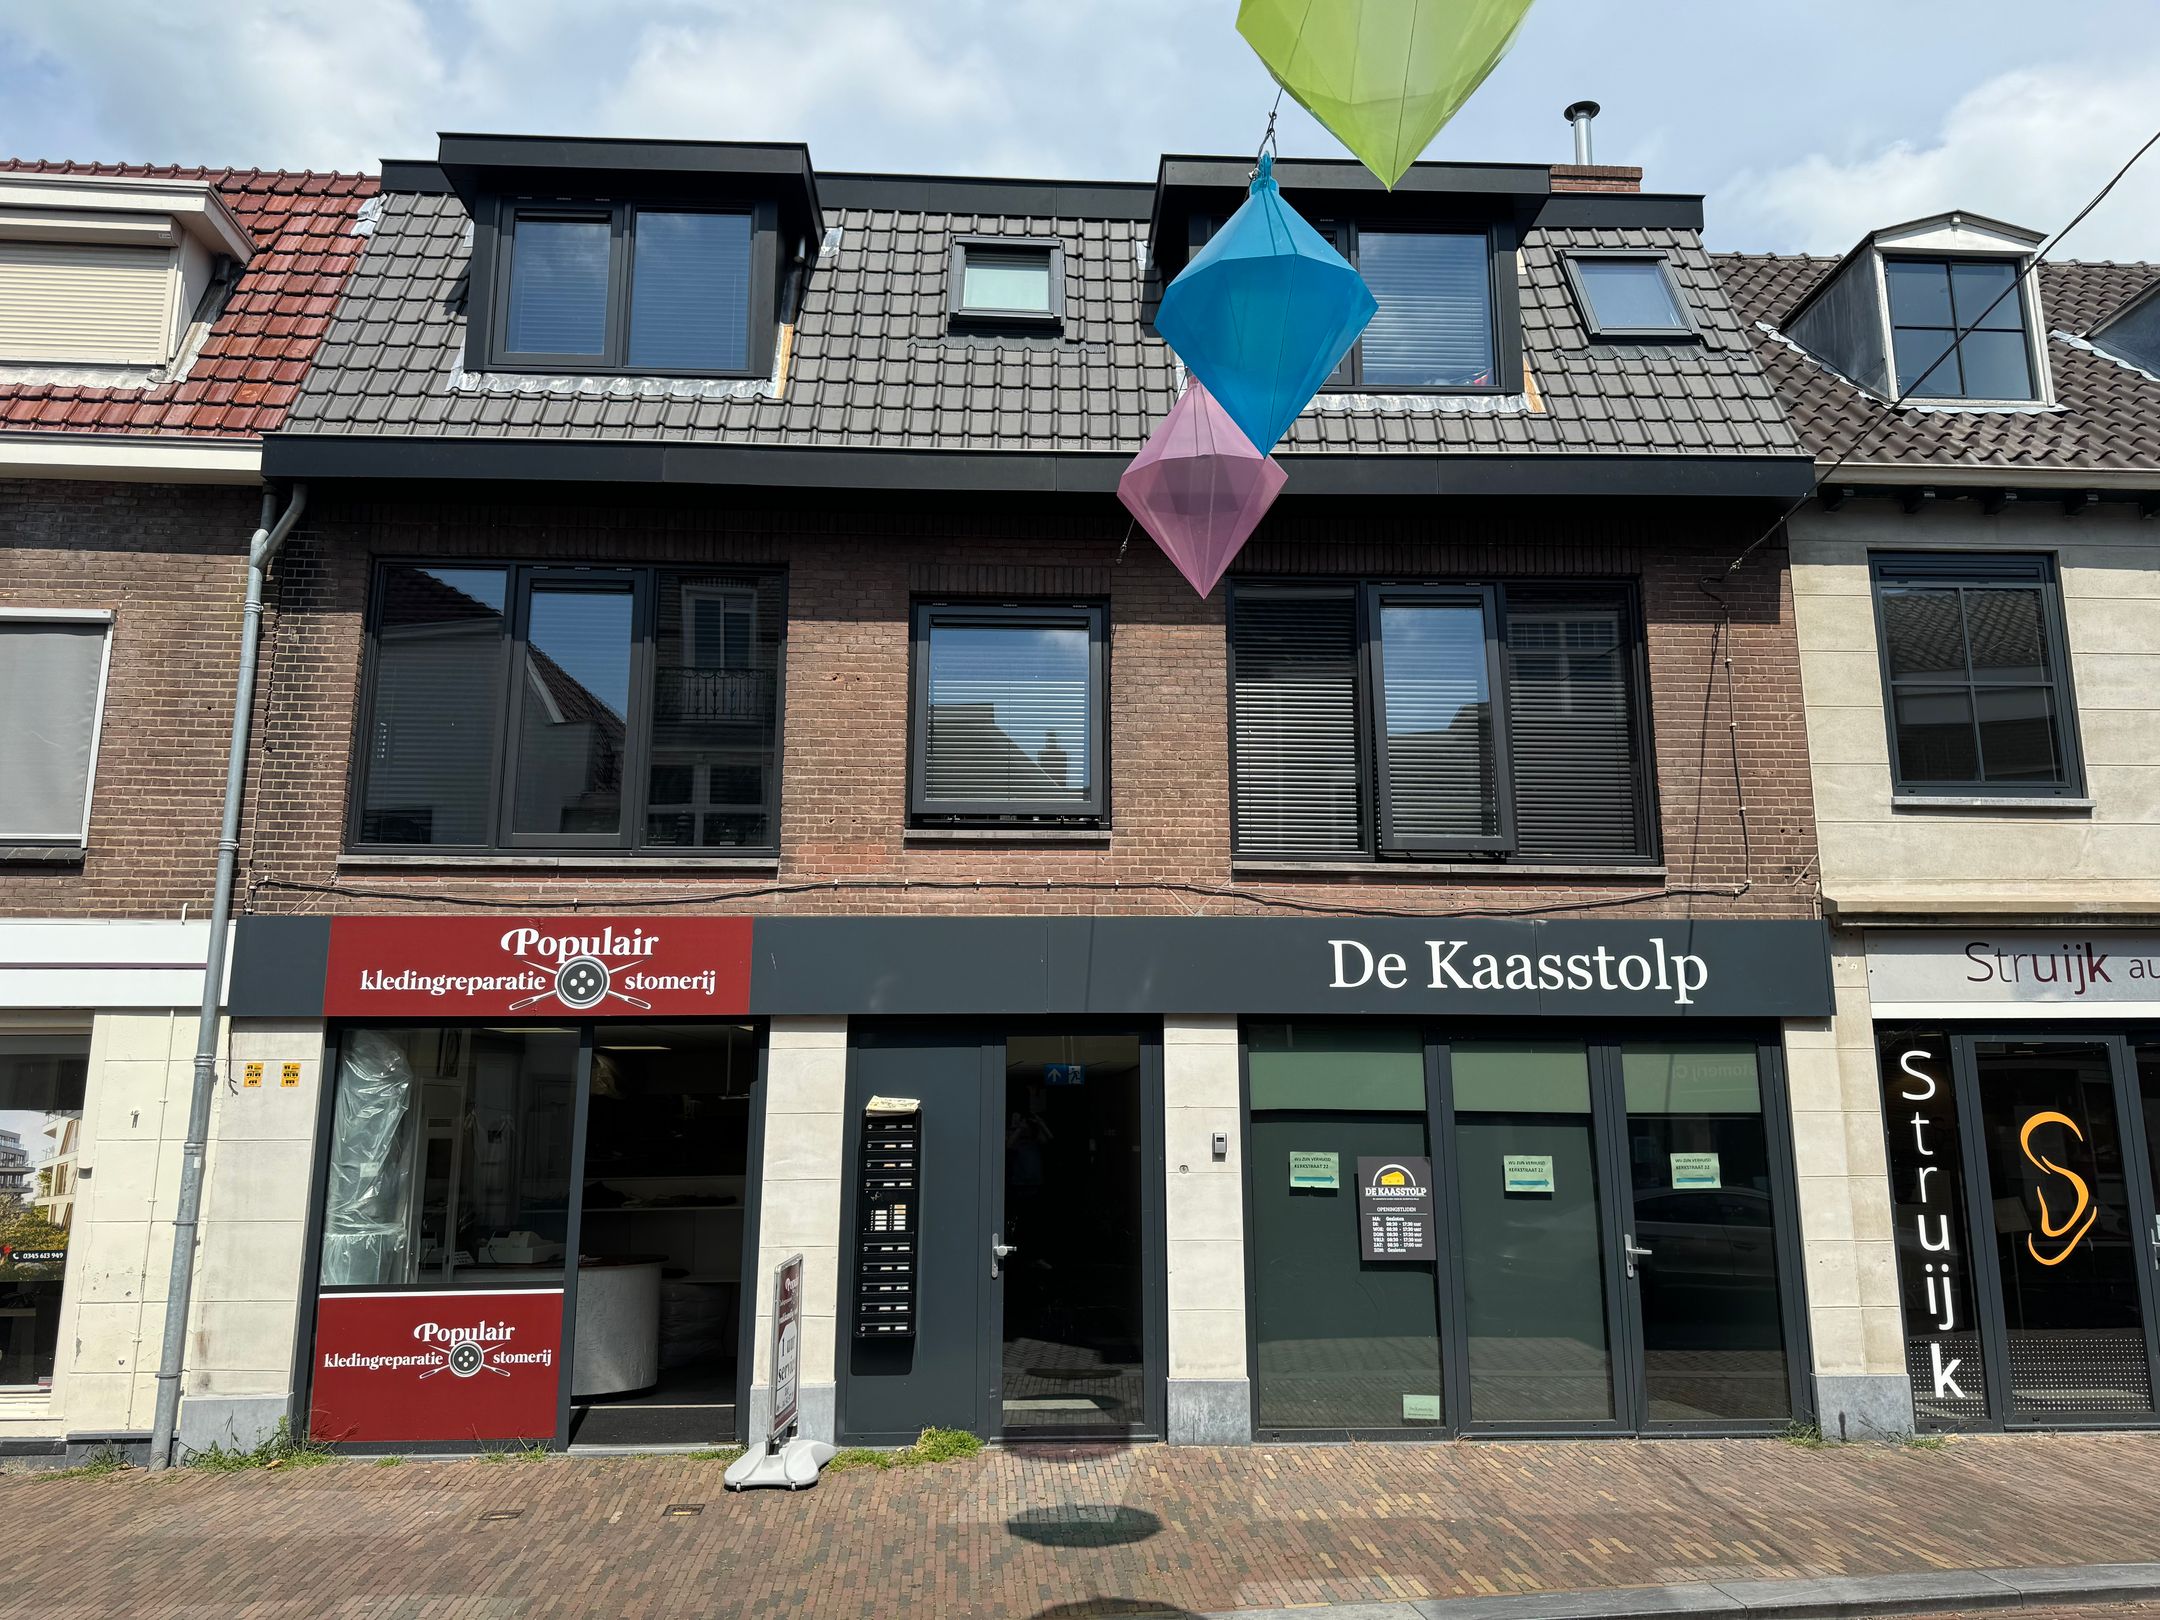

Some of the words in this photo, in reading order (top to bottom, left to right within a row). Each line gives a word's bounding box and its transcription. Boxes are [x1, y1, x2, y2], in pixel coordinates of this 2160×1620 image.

[500, 926, 659, 964] Populair
[360, 969, 546, 996] kledingreparatie
[624, 970, 716, 996] stomerij
[1328, 939, 1408, 990] De
[1424, 937, 1708, 1005] Kaasstolp
[1965, 941, 2112, 995] Struijk
[1365, 1187, 1376, 1196] DE
[1378, 1187, 1427, 1196] KAASSTOLP
[1899, 1049, 1966, 1400] Struijk
[413, 1320, 516, 1347] Populair
[324, 1351, 444, 1371] kledingreparatie
[493, 1349, 552, 1367] stomerij
